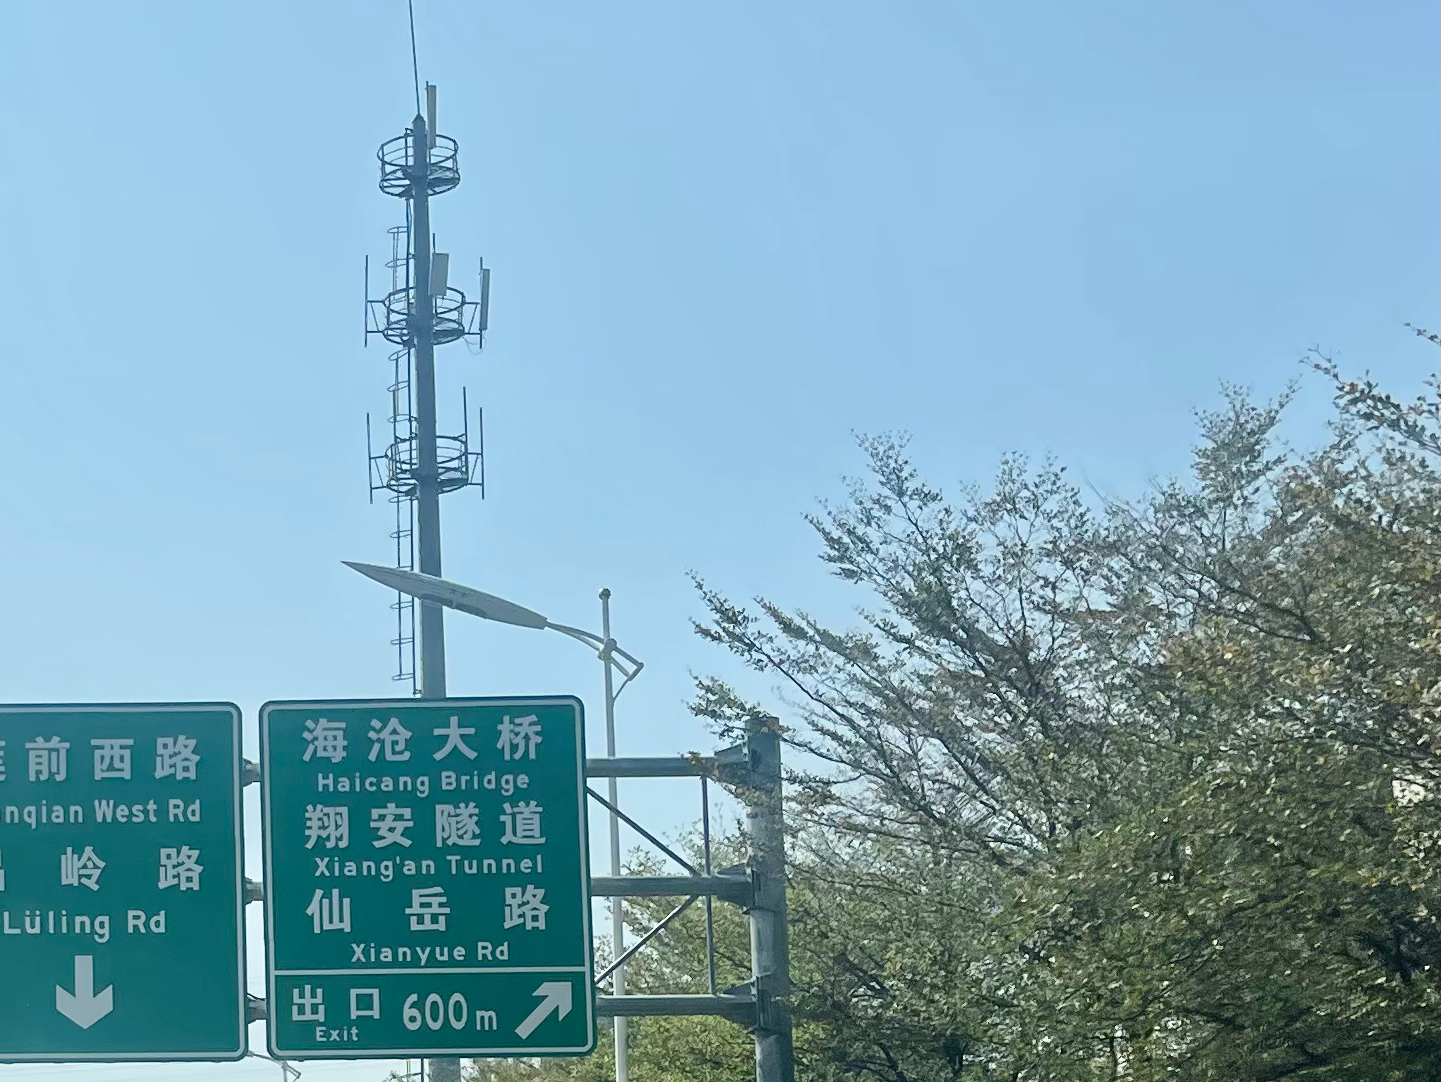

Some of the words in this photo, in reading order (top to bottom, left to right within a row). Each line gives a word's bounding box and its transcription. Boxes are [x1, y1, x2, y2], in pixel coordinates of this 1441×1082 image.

[302, 714, 543, 763] 海沧大桥
[317, 772, 430, 798] Haicang
[441, 770, 530, 796] Bridge
[94, 799, 157, 823] West
[168, 798, 201, 823] Rd
[304, 800, 546, 850] 翔安隧道
[314, 857, 436, 882] Xiang'an
[446, 854, 543, 875] Tunnel
[305, 884, 550, 934] 仙岳路
[3, 909, 110, 943] Lüling
[127, 910, 166, 934] Rd
[350, 943, 466, 966] Xianyue
[477, 941, 509, 961] Rd
[291, 984, 380, 1023] 出口
[315, 1026, 359, 1042] Exit
